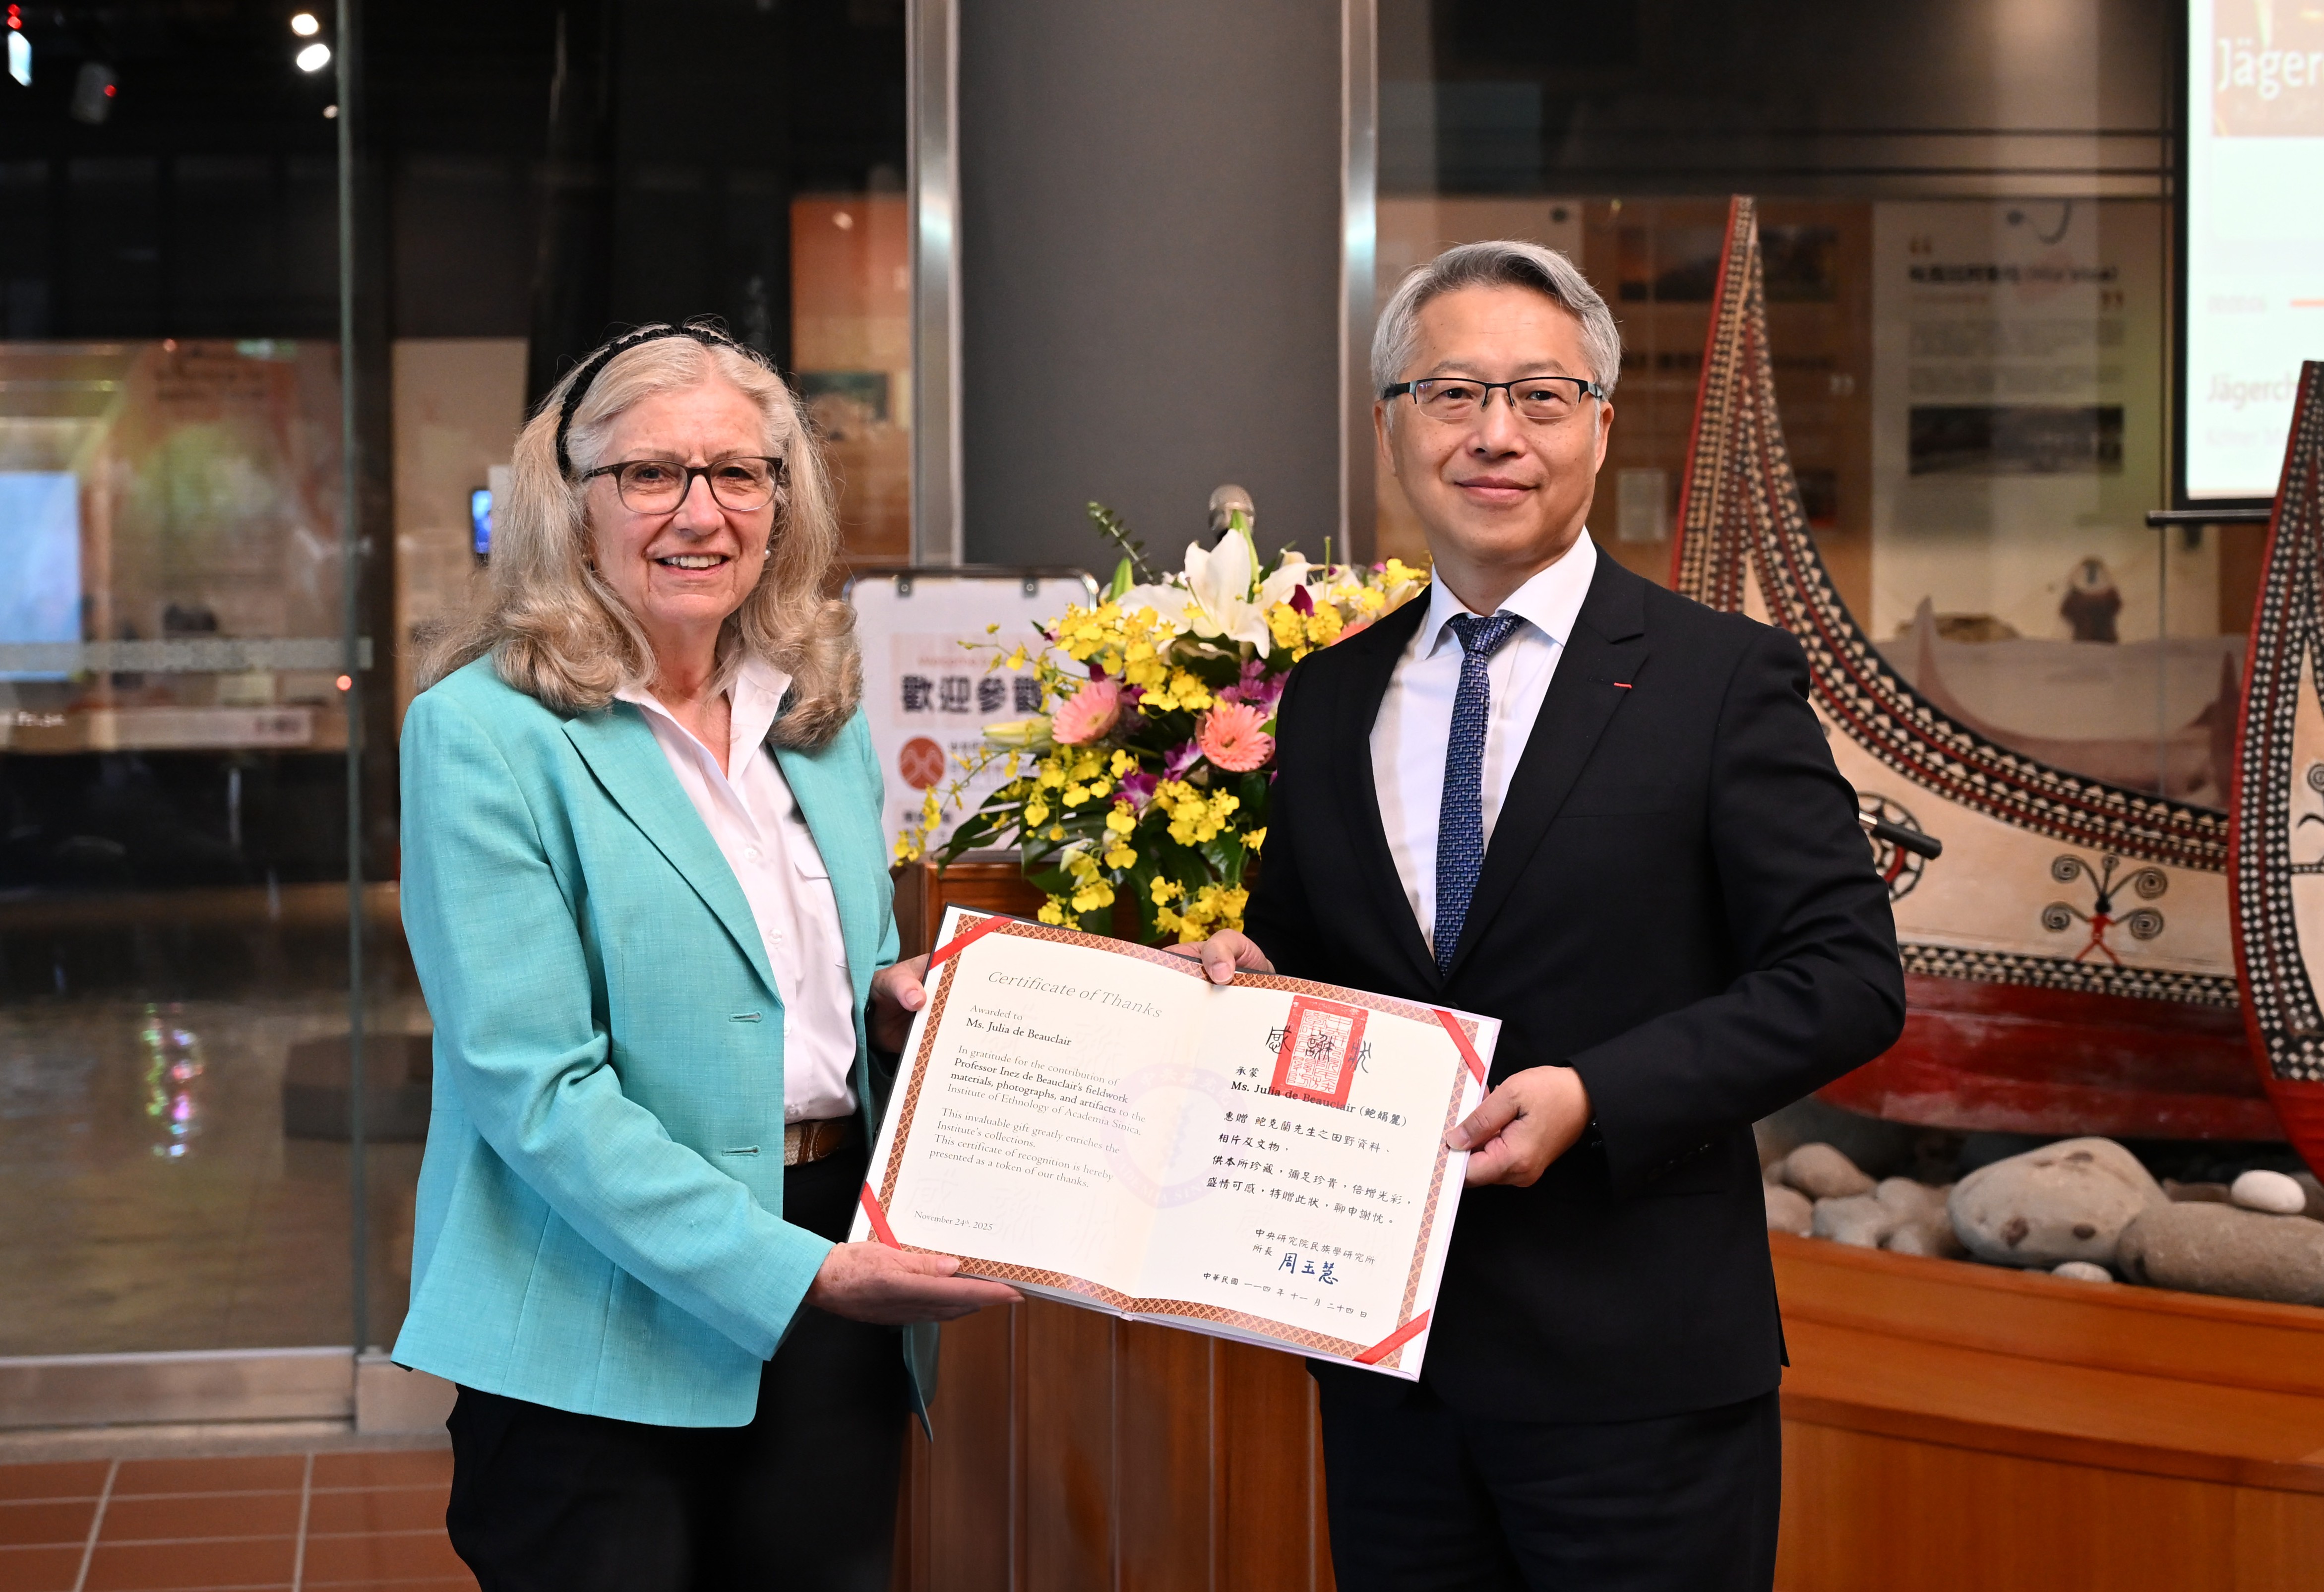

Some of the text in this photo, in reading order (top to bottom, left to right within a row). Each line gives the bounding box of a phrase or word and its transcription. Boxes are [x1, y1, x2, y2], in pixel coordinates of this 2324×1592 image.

[970, 1005, 1011, 1018] Awarded
[989, 972, 1162, 1017] Certificate of Thanks
[966, 1018, 1072, 1045] Ms. Julia de Beauclair
[954, 1058, 1128, 1103] Professor Inez de Beauclair's fieldwork
[958, 1045, 1120, 1087] In gratitude for the contribution of
[1235, 1066, 1259, 1078] 承蒙
[948, 1084, 1140, 1135] Institute of Ethnology of Academia Sinica.
[951, 1074, 993, 1087] materials,
[996, 1081, 1056, 1100] photographs,
[1080, 1100, 1116, 1113] artifacts
[1132, 1111, 1146, 1122] the
[1231, 1081, 1249, 1092] Ms.
[1254, 1084, 1281, 1097] Julia
[1284, 1089, 1298, 1100] de
[1302, 1093, 1356, 1113] Beauclair
[937, 1121, 1035, 1147] Institute's collections.
[942, 1107, 1120, 1154] This invaluable gift greatly enriches the
[1224, 1111, 1248, 1123] 惠贈
[929, 1151, 974, 1163] presented
[996, 1161, 1021, 1172] token
[1025, 1166, 1038, 1175] of
[1057, 1173, 1088, 1187] thanks.
[935, 1134, 954, 1145] This
[958, 1142, 1002, 1154] certificate
[1005, 1149, 1018, 1157] of
[1018, 1153, 1069, 1168] recognition
[1083, 1164, 1113, 1182] hereby
[915, 1211, 953, 1224] November
[973, 1222, 993, 1230] 2025
[1252, 1244, 1272, 1256] 所長
[1256, 1229, 1375, 1265] 中央研究院民族學研究所
[1278, 1253, 1339, 1285] 周玉慧
